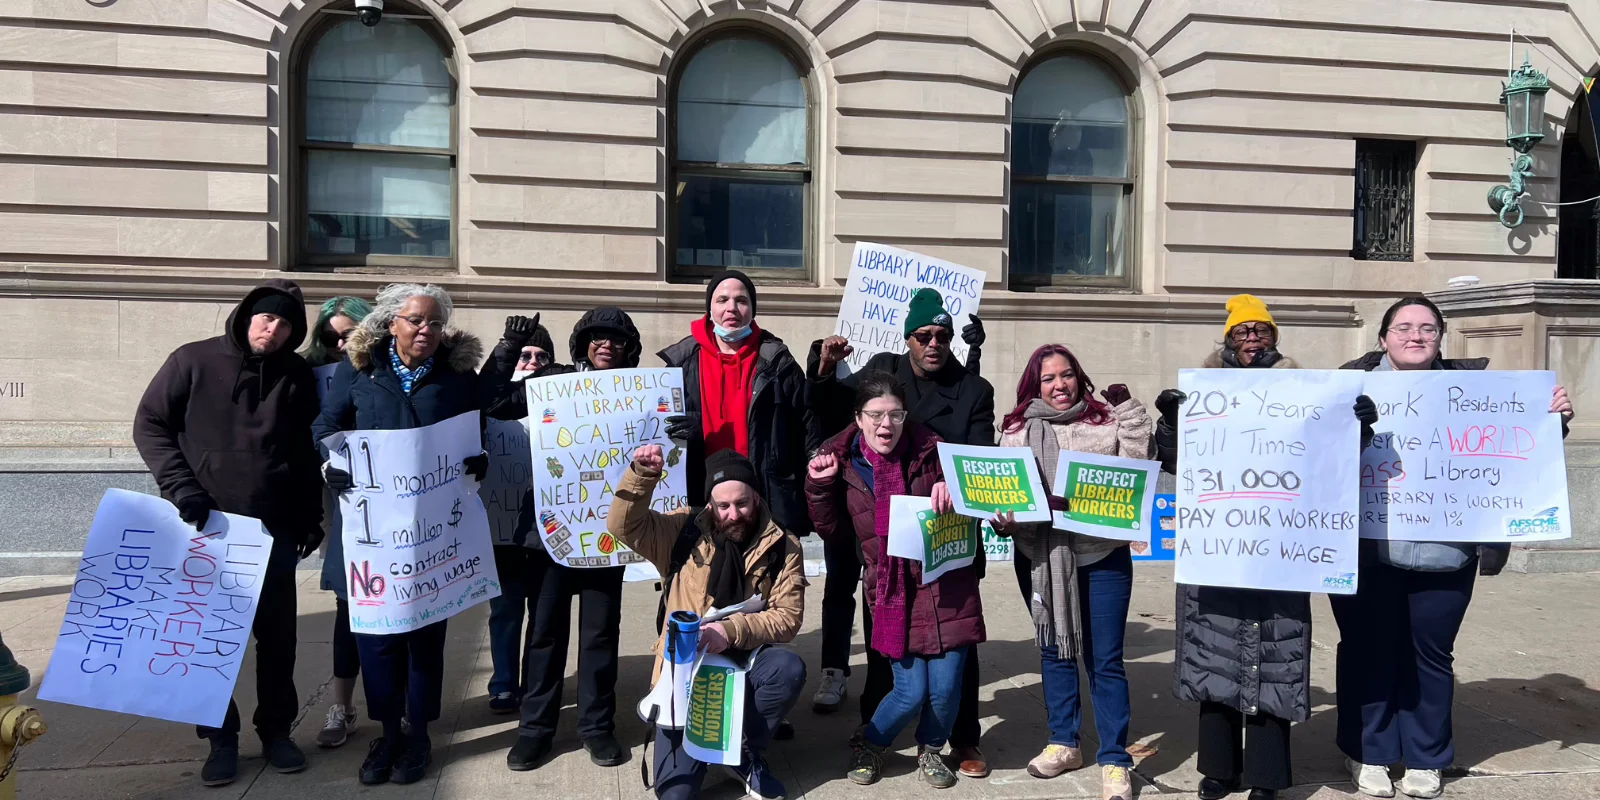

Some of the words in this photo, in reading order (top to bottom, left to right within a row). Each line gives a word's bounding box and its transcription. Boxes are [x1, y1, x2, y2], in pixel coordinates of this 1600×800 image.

[857, 249, 914, 279] LIBRARY
[916, 261, 979, 299] WORKERS
[858, 276, 909, 303] SHOULD
[862, 300, 900, 326] HAVE
[839, 320, 906, 355] DELIVER
[529, 377, 604, 404] NEWARK
[613, 372, 672, 393] PUBLIC
[1448, 386, 1525, 415] Residents
[574, 395, 647, 418] LIBRARY
[1185, 390, 1241, 418] 20+
[1252, 390, 1325, 421] Years
[539, 423, 623, 451] LOCAL
[1184, 428, 1226, 458] Full
[1241, 428, 1306, 457] Time
[1368, 433, 1422, 451] erve
[1429, 427, 1443, 450] A
[1447, 424, 1536, 454] WORLD
[569, 443, 666, 470] WORK
[962, 459, 1017, 476] RESPECT
[393, 454, 462, 493] months
[500, 462, 531, 484] NO
[965, 474, 1020, 490] LIBRARY
[1077, 467, 1137, 488] RESPECT
[1182, 468, 1301, 500] $31,000
[1361, 460, 1406, 485] ASS
[1424, 457, 1502, 486] Library
[540, 482, 589, 508] NEED
[600, 480, 616, 500] A
[965, 487, 1029, 505] WORKERS
[1074, 483, 1134, 503] LIBRARY
[1366, 492, 1434, 505] LIBRARY
[1444, 492, 1458, 504] IS
[1467, 494, 1523, 510] WORTH
[355, 495, 384, 548] 1
[393, 518, 443, 545] million
[447, 498, 463, 530] $
[561, 504, 611, 525] WAG
[1069, 497, 1135, 520] WORKERS
[1179, 507, 1216, 529] PAY
[1225, 506, 1271, 528] OUR
[1279, 508, 1356, 531] WORKERS
[1397, 512, 1431, 525] THAN
[1444, 510, 1463, 527] 1%
[1509, 517, 1558, 528] AFSCME
[931, 525, 968, 550] LIBRARY
[1510, 526, 1537, 534] LOCAL
[931, 540, 968, 566] RESPECT
[1180, 538, 1193, 557] A
[1204, 537, 1270, 557] LIVING
[1281, 541, 1337, 564] WAGE
[350, 560, 387, 599] No
[389, 538, 462, 576] contract
[393, 579, 440, 603] living
[444, 556, 481, 583] wage
[60, 552, 113, 640] WORK
[80, 529, 155, 676] LIBRARIES
[127, 566, 176, 641] MAKE
[148, 531, 222, 677] WORKERS
[190, 543, 262, 681] LIBRARY
[385, 613, 419, 629] Library
[419, 600, 454, 621] Workers
[691, 675, 707, 737] LIBRARY
[703, 672, 725, 742] WORKERS
